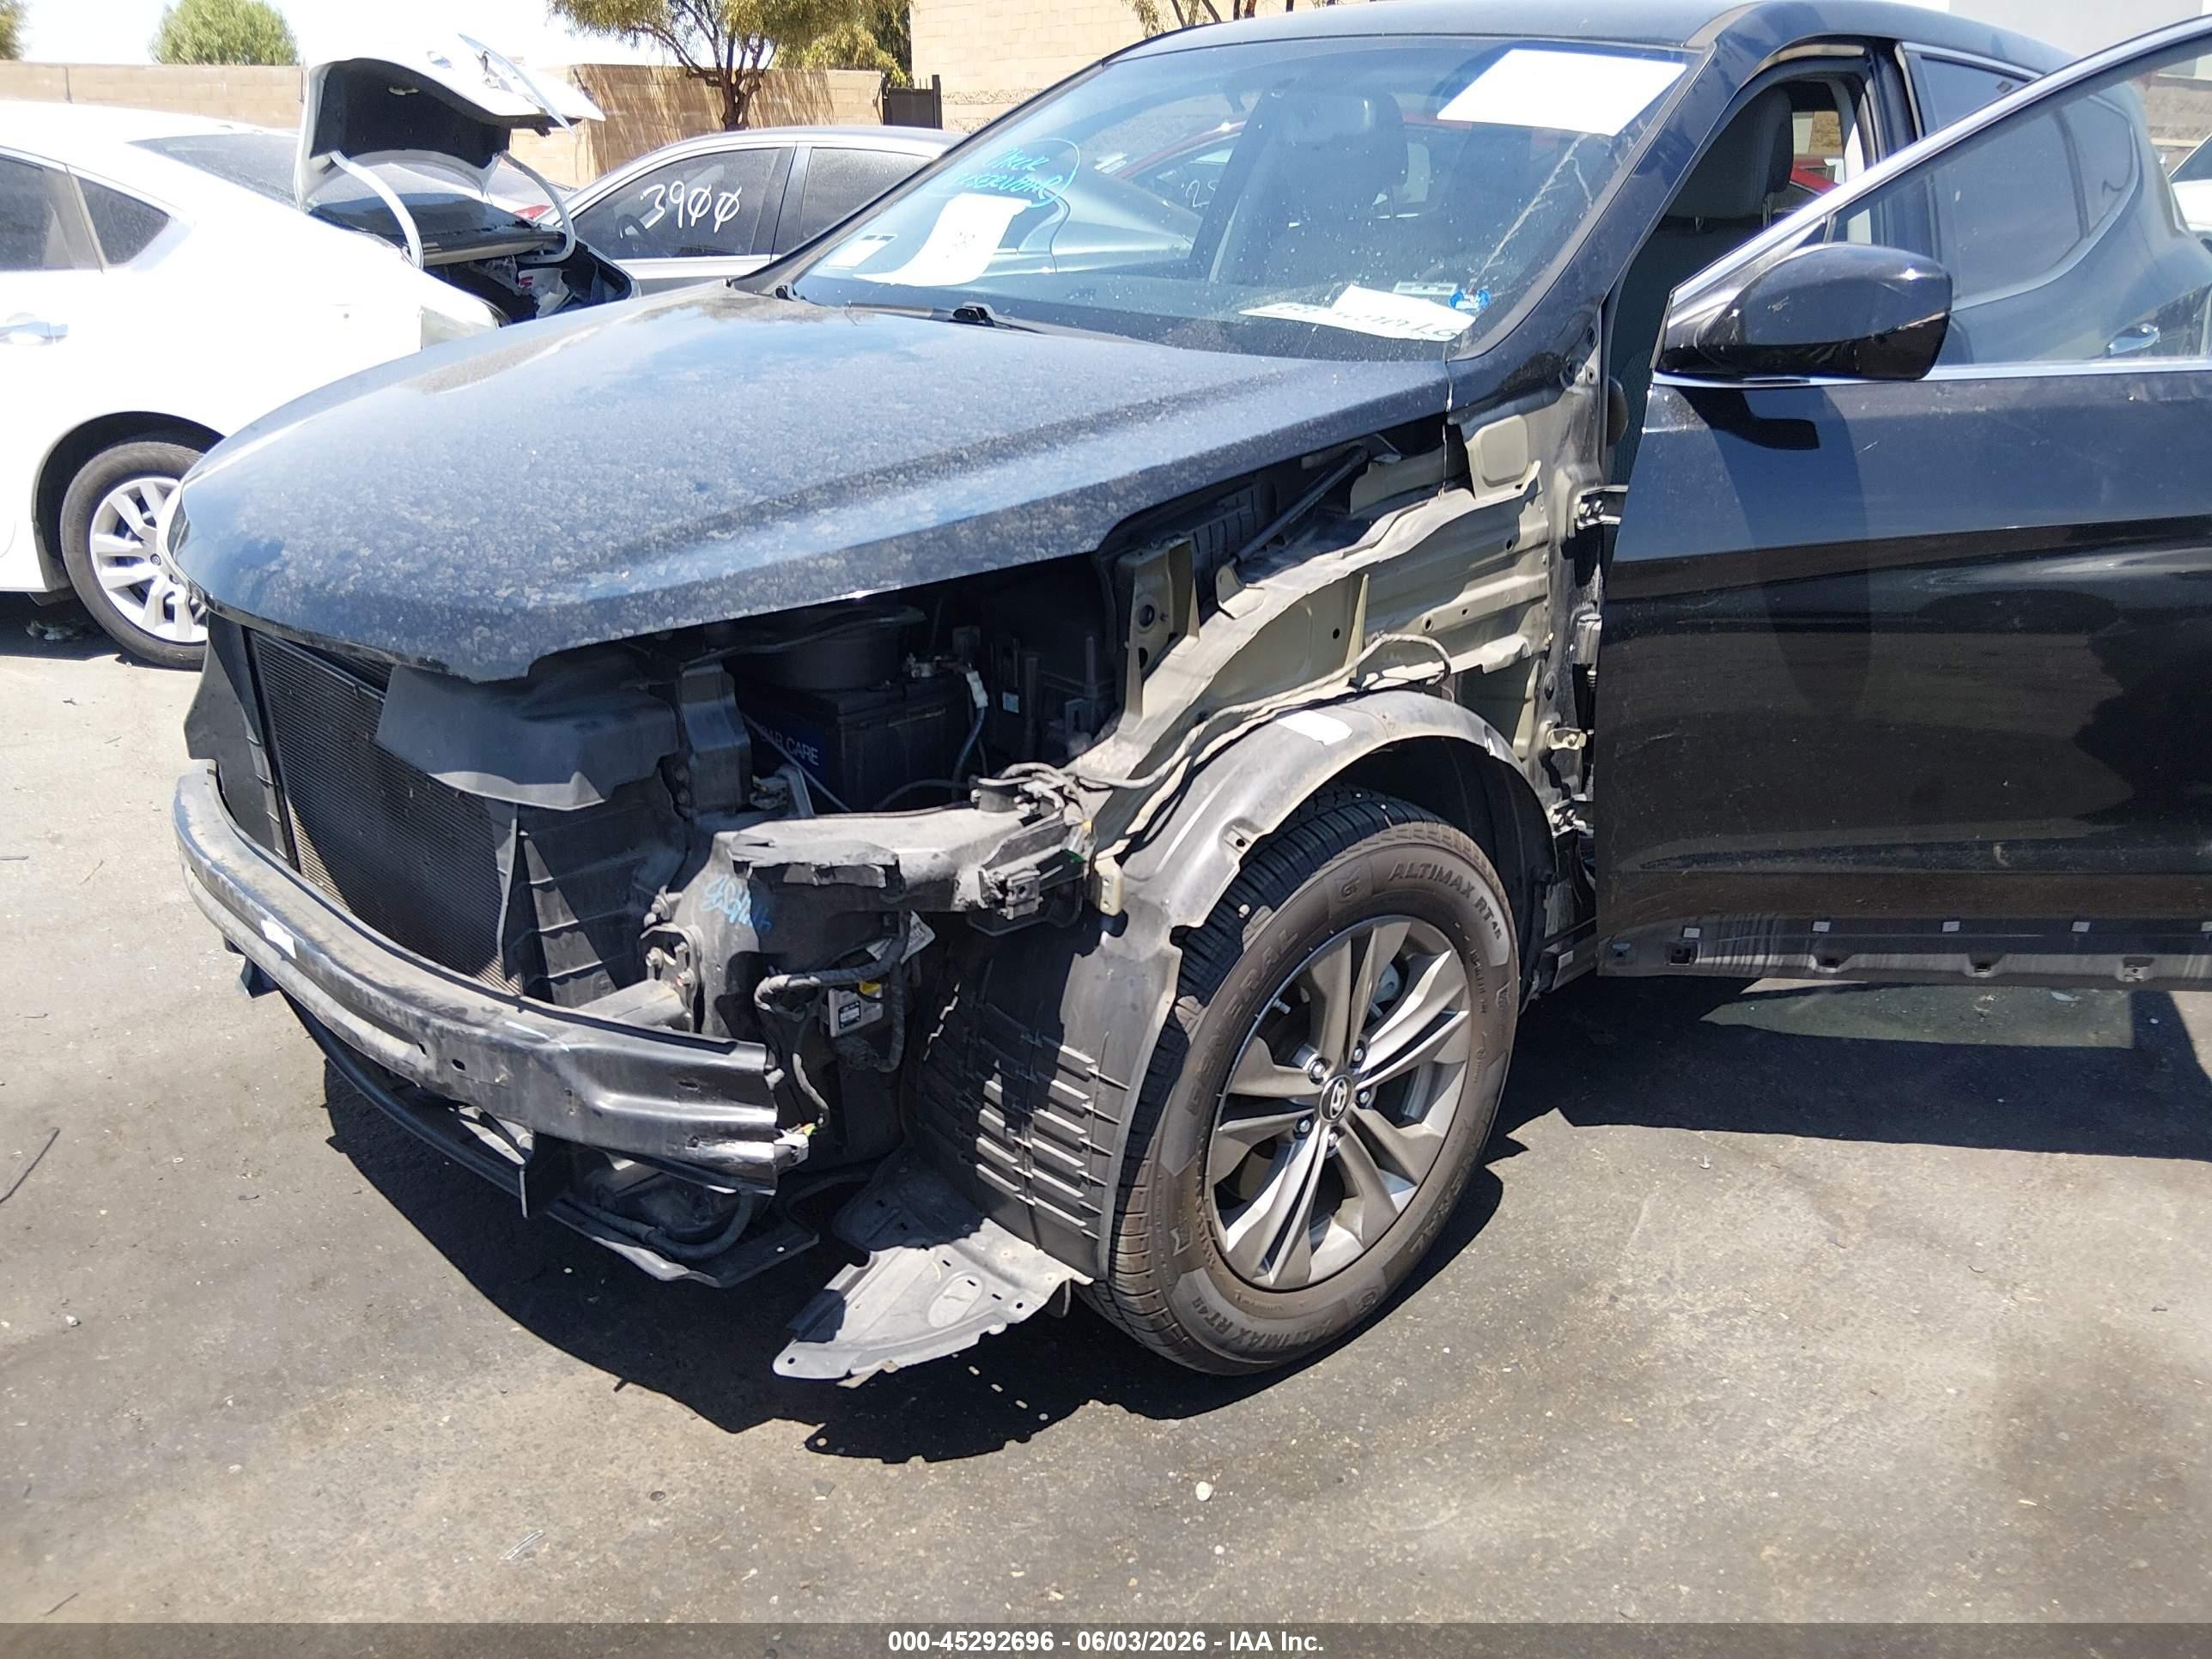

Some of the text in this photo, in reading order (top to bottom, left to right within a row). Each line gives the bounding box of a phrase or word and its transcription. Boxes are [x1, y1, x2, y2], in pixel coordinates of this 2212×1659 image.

[640, 180, 743, 233] 3900
[785, 737, 819, 767] CARE
[1388, 860, 1476, 899] ALTIMAX
